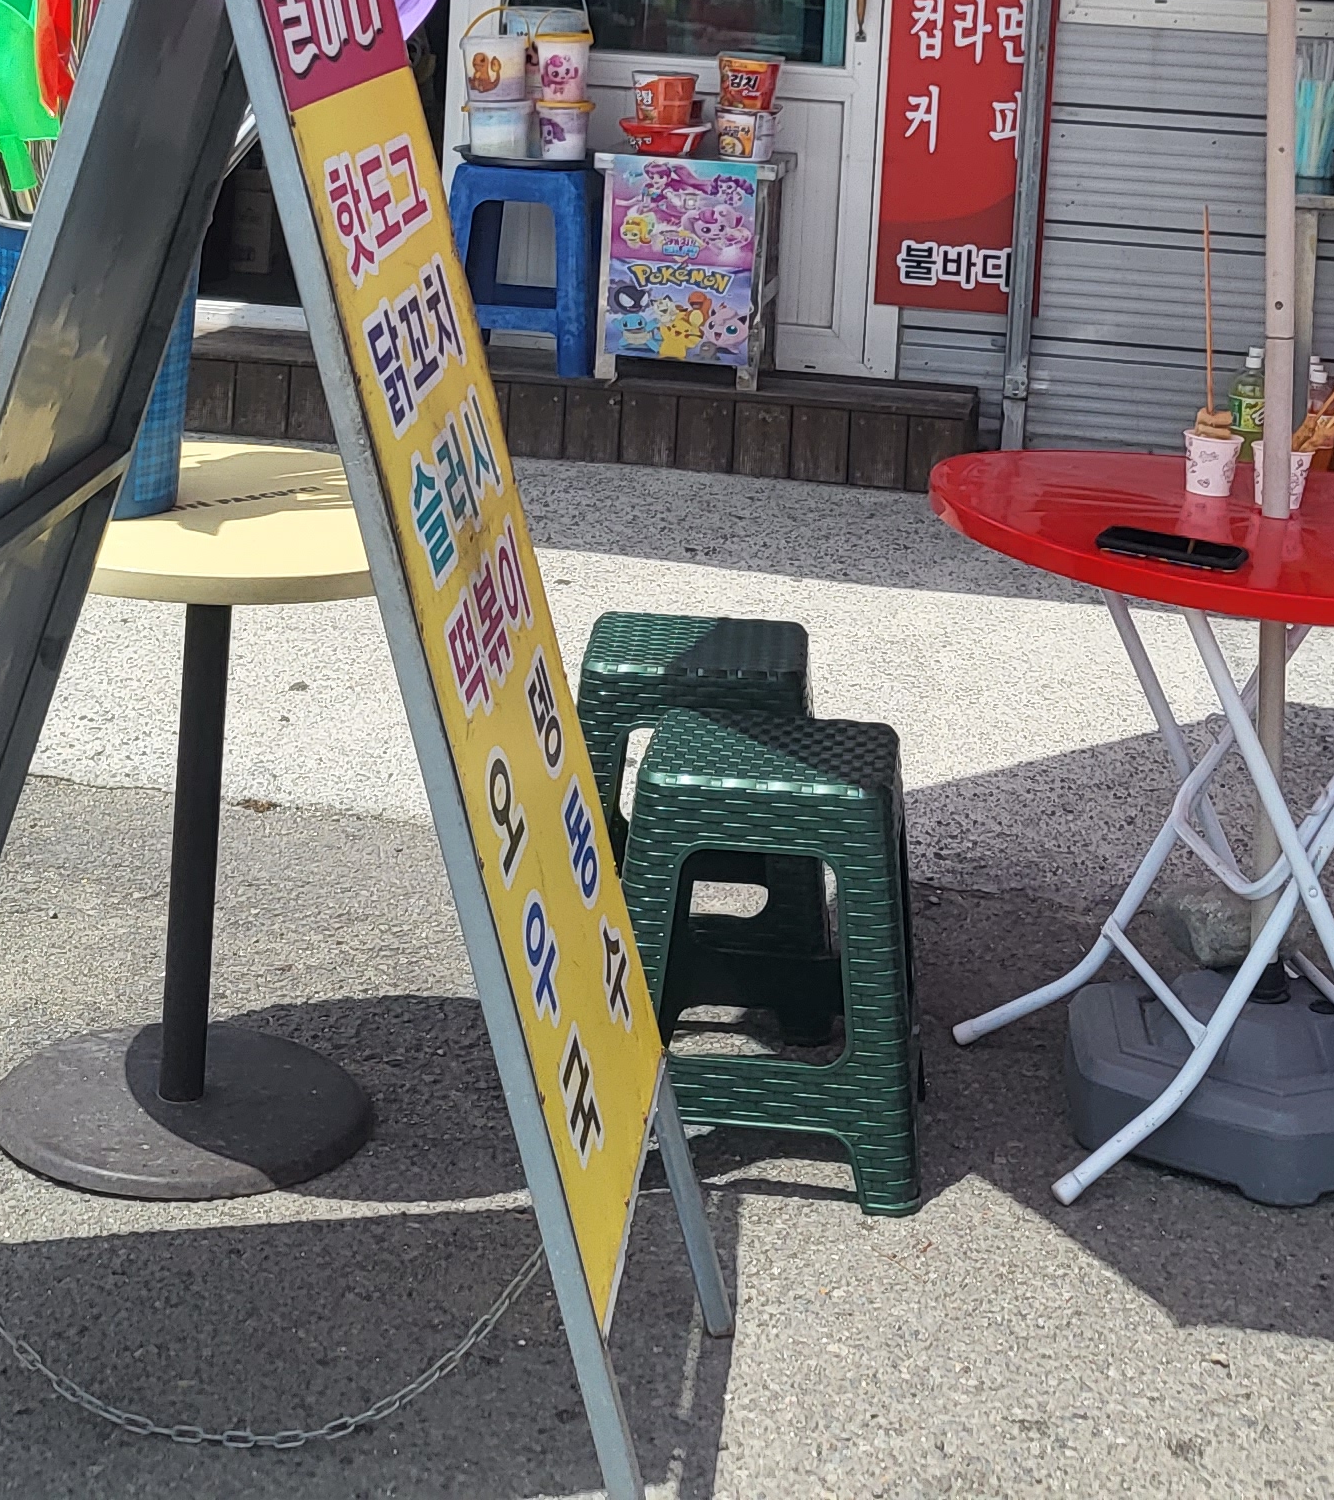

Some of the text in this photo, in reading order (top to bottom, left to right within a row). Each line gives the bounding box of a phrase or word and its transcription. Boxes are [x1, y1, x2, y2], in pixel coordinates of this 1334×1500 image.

[730, 74, 759, 89] 김치
[328, 142, 428, 276] 핫도그
[369, 264, 465, 430] 닭꼬치
[215, 485, 324, 505] PASCUCCI
[413, 393, 499, 576] 슬러시
[451, 525, 531, 706] 떡볶이
